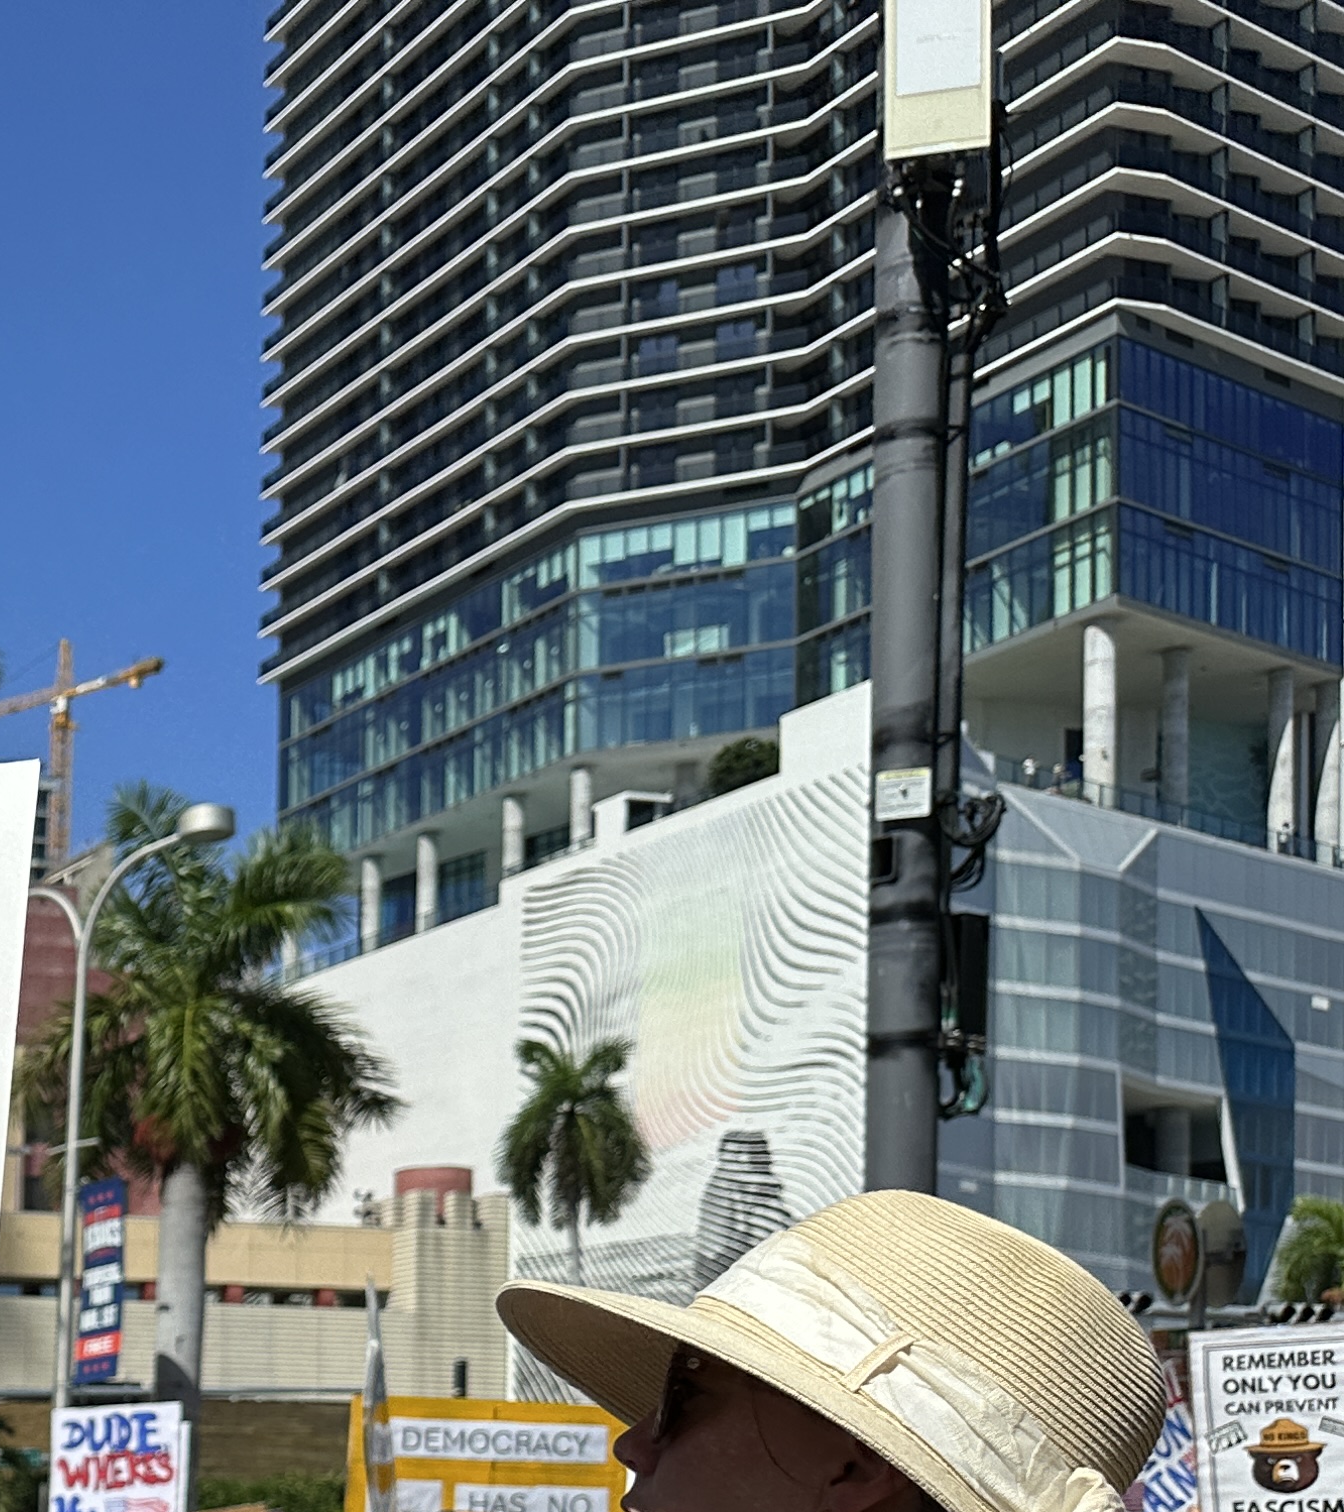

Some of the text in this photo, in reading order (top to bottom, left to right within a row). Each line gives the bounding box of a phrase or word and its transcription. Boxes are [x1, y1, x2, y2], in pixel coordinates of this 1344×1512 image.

[1222, 1350, 1336, 1372] REMEMBER
[1223, 1373, 1337, 1395] ONLY YOU
[1224, 1397, 1339, 1416] CAN PREVENT
[63, 1410, 161, 1452] DUDE
[401, 1425, 590, 1457] DEMOCRACY
